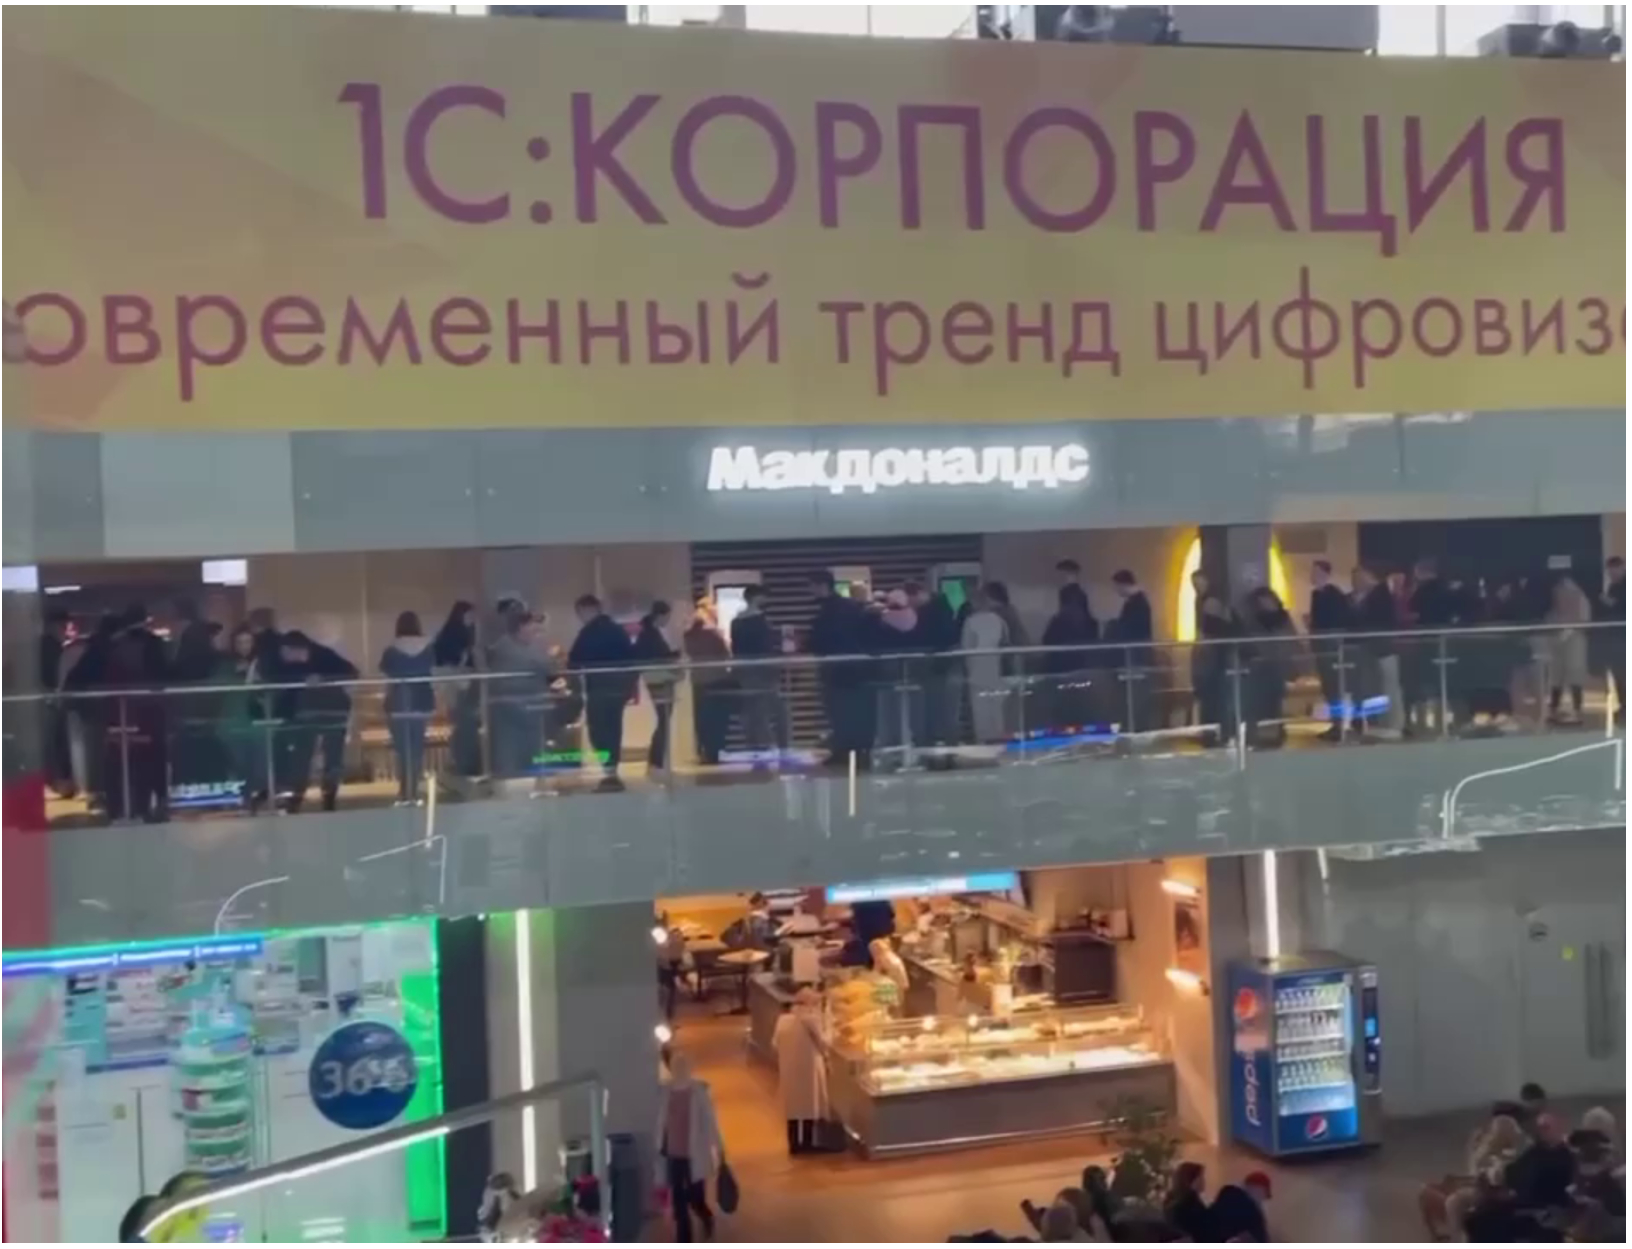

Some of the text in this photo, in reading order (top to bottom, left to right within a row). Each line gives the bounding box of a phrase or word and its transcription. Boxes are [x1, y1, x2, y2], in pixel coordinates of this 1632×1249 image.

[337, 82, 1569, 258] 1С:КОРПОРАЦИЯ
[13, 265, 1626, 403] овременный тренд цифровиз
[706, 443, 1091, 495] Макдоналдс
